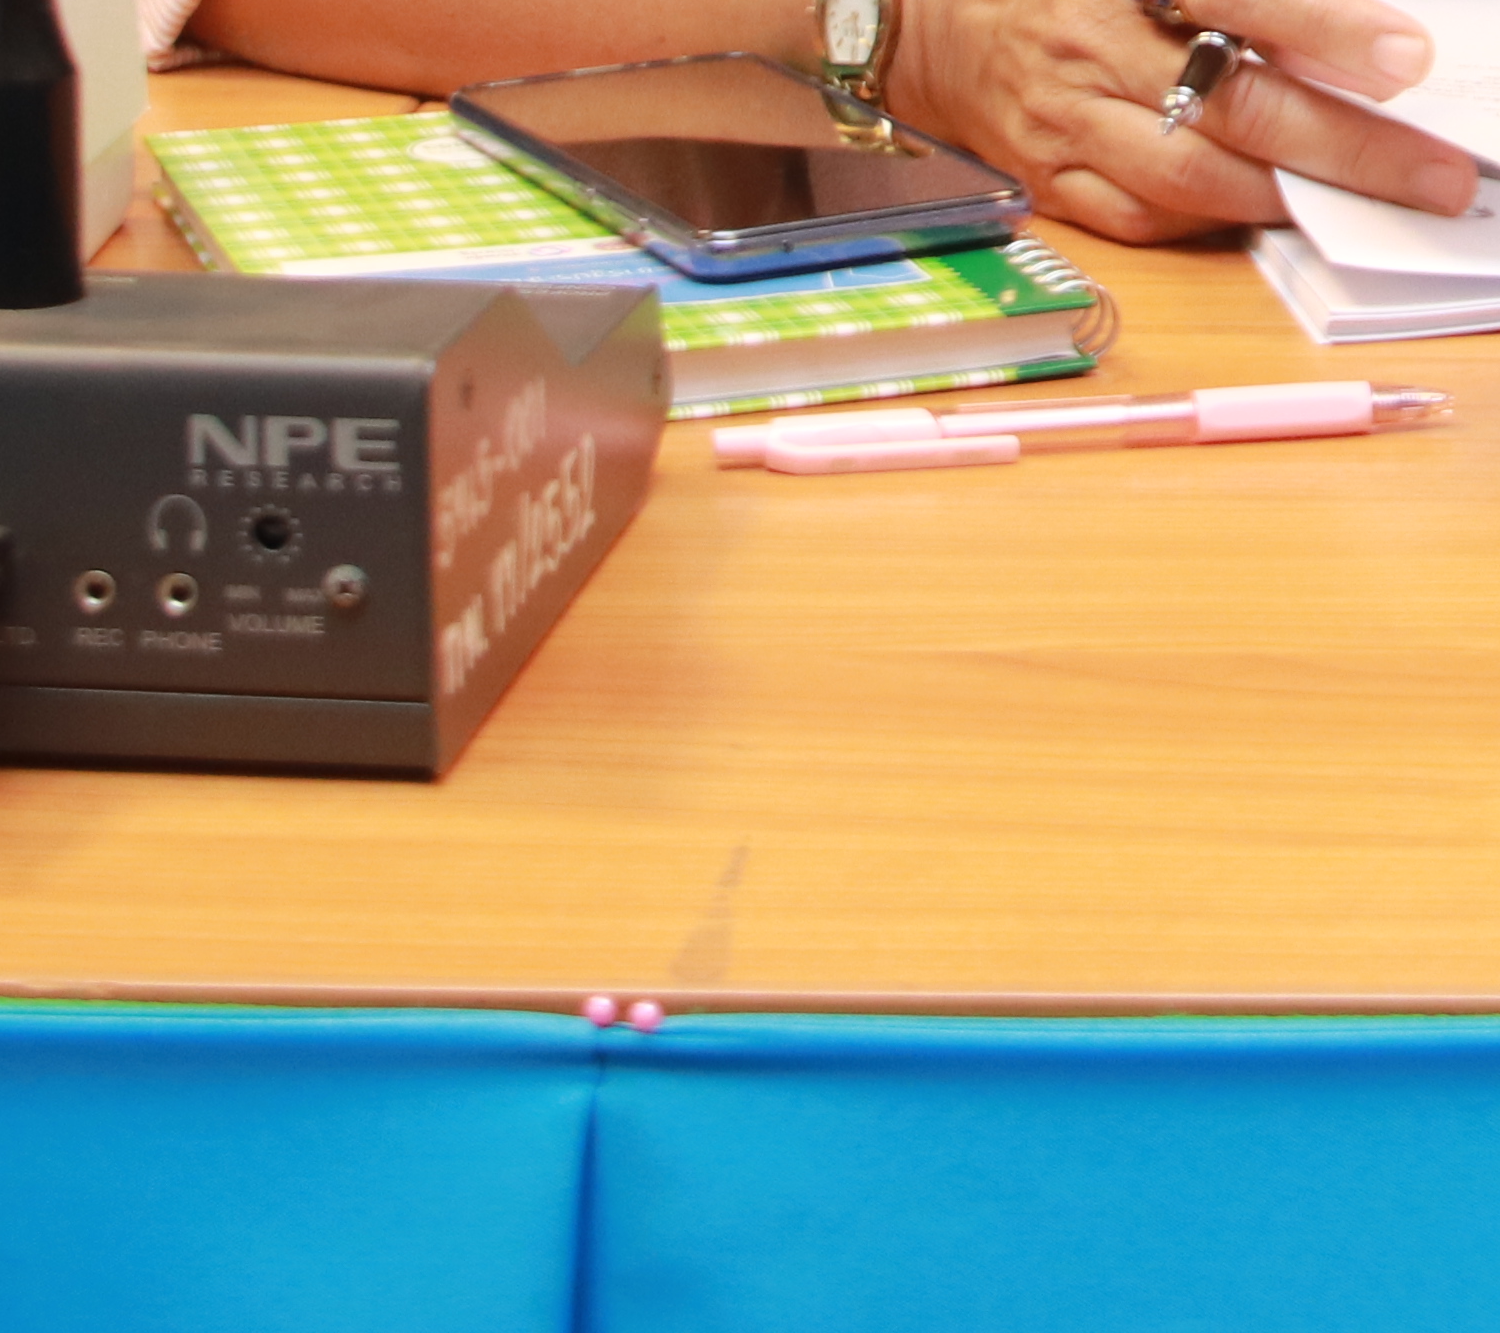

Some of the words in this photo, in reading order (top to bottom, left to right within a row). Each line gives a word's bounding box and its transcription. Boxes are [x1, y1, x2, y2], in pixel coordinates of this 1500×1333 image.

[187, 413, 401, 471] NPE
[187, 468, 401, 491] RESEARCH
[228, 614, 326, 635] VOLUME
[73, 626, 126, 648] REC
[138, 629, 224, 652] PHONE
